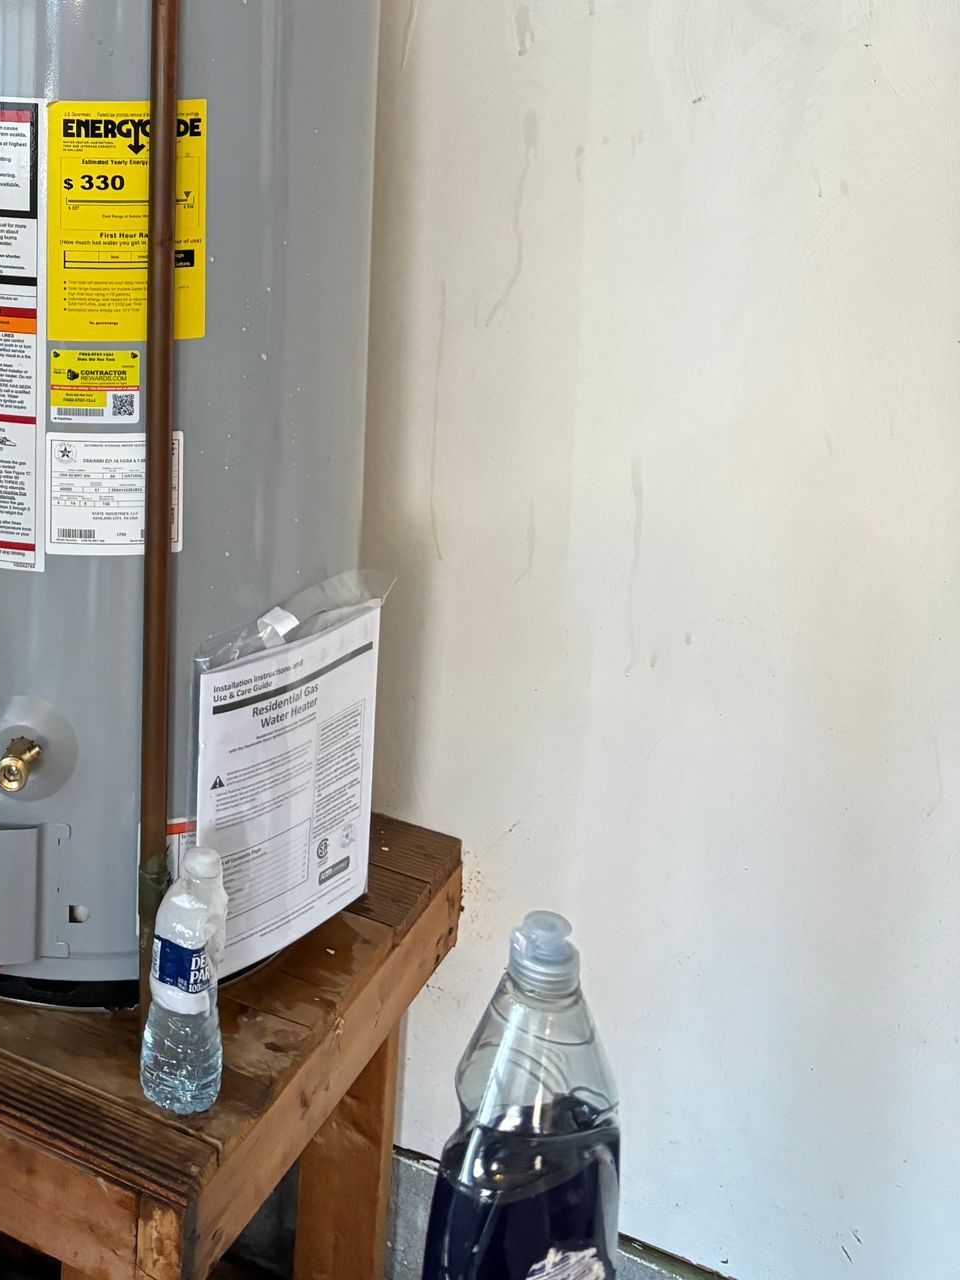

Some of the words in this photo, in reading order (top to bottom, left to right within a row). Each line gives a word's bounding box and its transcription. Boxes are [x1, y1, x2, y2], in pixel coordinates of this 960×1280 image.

[63, 178, 74, 191] $
[80, 175, 125, 191] 330
[213, 678, 252, 693] Installation
[254, 666, 291, 682] Instructions
[292, 659, 303, 670] and
[213, 694, 227, 702] Use
[236, 688, 252, 696] Care
[253, 681, 272, 692] Guide
[252, 689, 302, 717] Residential
[304, 684, 318, 697] Gas
[260, 710, 289, 728] Water
[290, 697, 318, 717] Heater
[191, 954, 208, 970] DE
[190, 966, 210, 984] PAR
